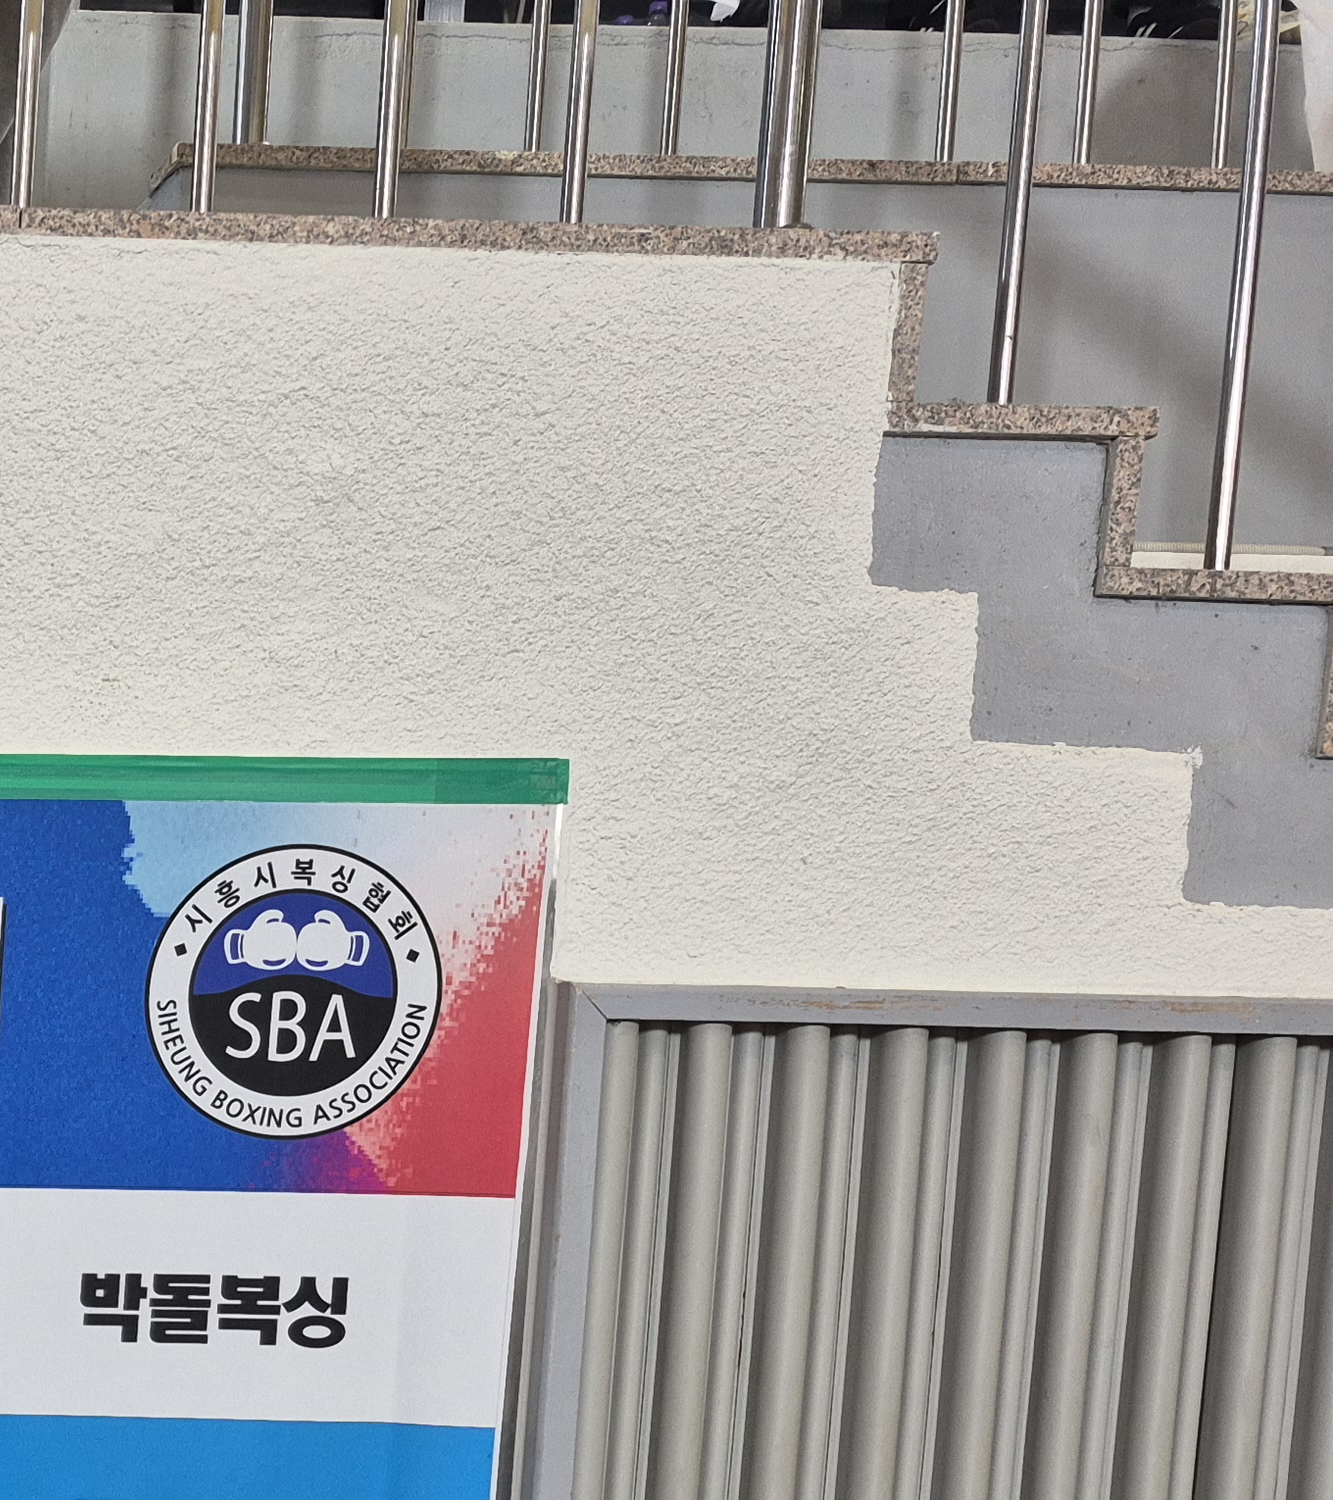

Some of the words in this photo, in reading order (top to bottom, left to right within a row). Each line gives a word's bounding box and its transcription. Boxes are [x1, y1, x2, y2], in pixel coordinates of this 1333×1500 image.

[184, 858, 419, 941] 시흥시복싱협회
[156, 999, 211, 1098] SIHEUNG
[210, 1088, 304, 1129] BOXING
[312, 1002, 428, 1126] ASSOCIATION
[225, 990, 356, 1063] SBA
[79, 1273, 349, 1348] 박돌복싱
